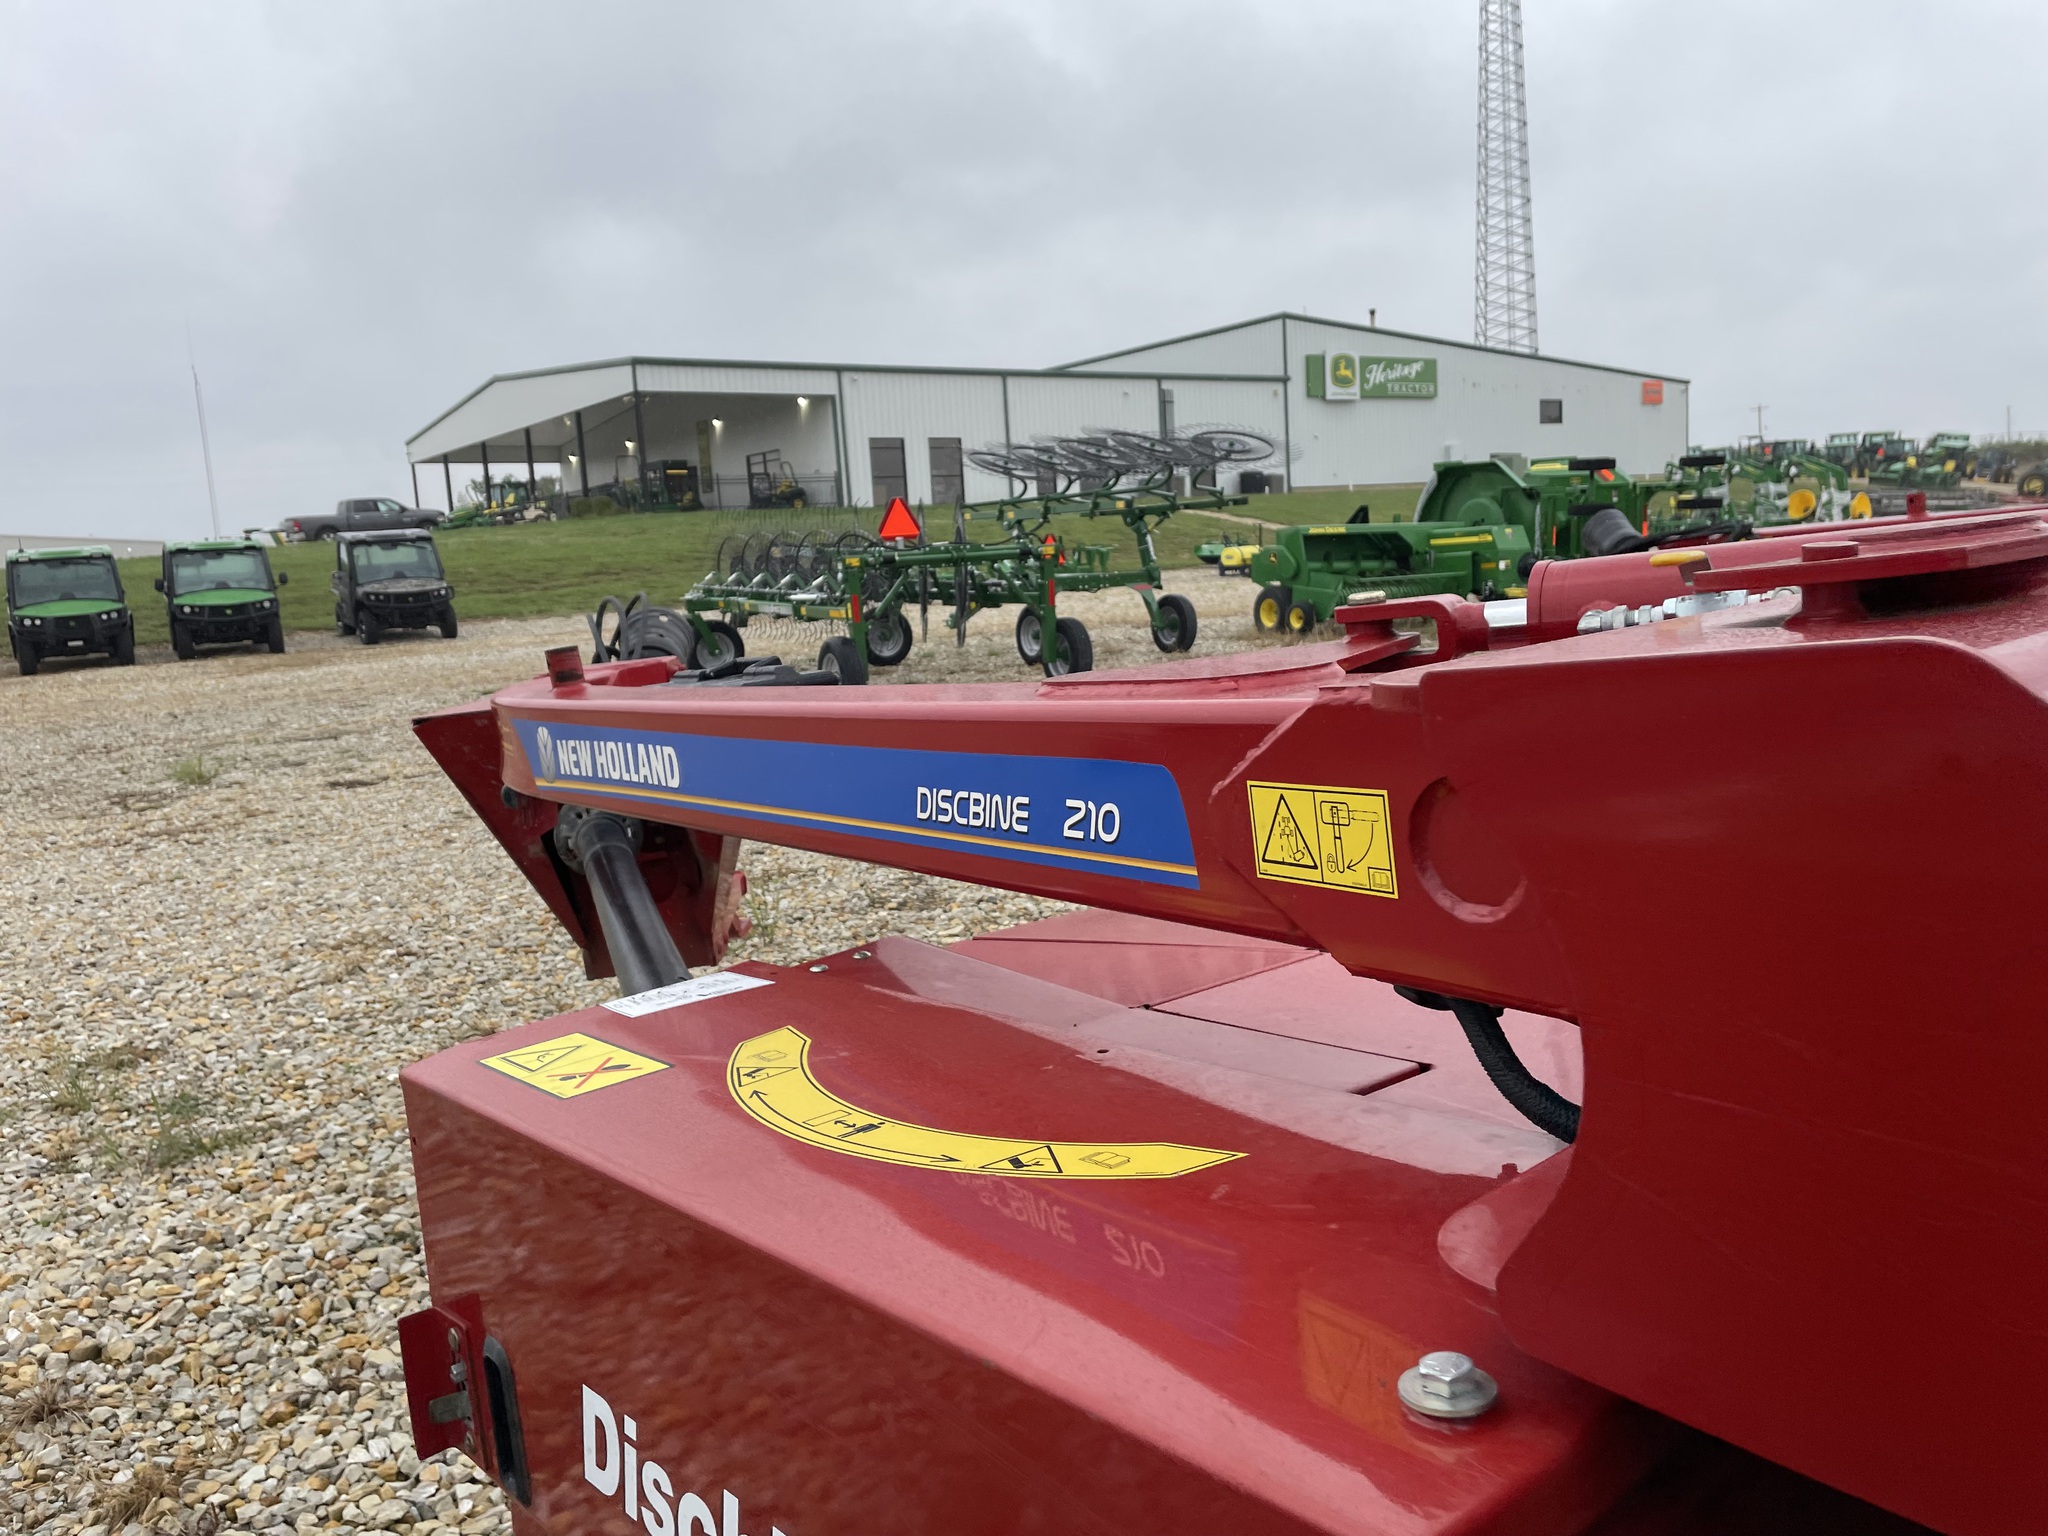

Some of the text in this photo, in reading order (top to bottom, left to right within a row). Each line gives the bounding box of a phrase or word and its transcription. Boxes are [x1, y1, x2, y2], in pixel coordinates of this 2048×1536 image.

[1364, 361, 1425, 391] Heritage
[1386, 383, 1435, 394] TRACTOR
[556, 739, 680, 788] NEW HOLLAND
[916, 786, 1121, 843] DISCBINE 210
